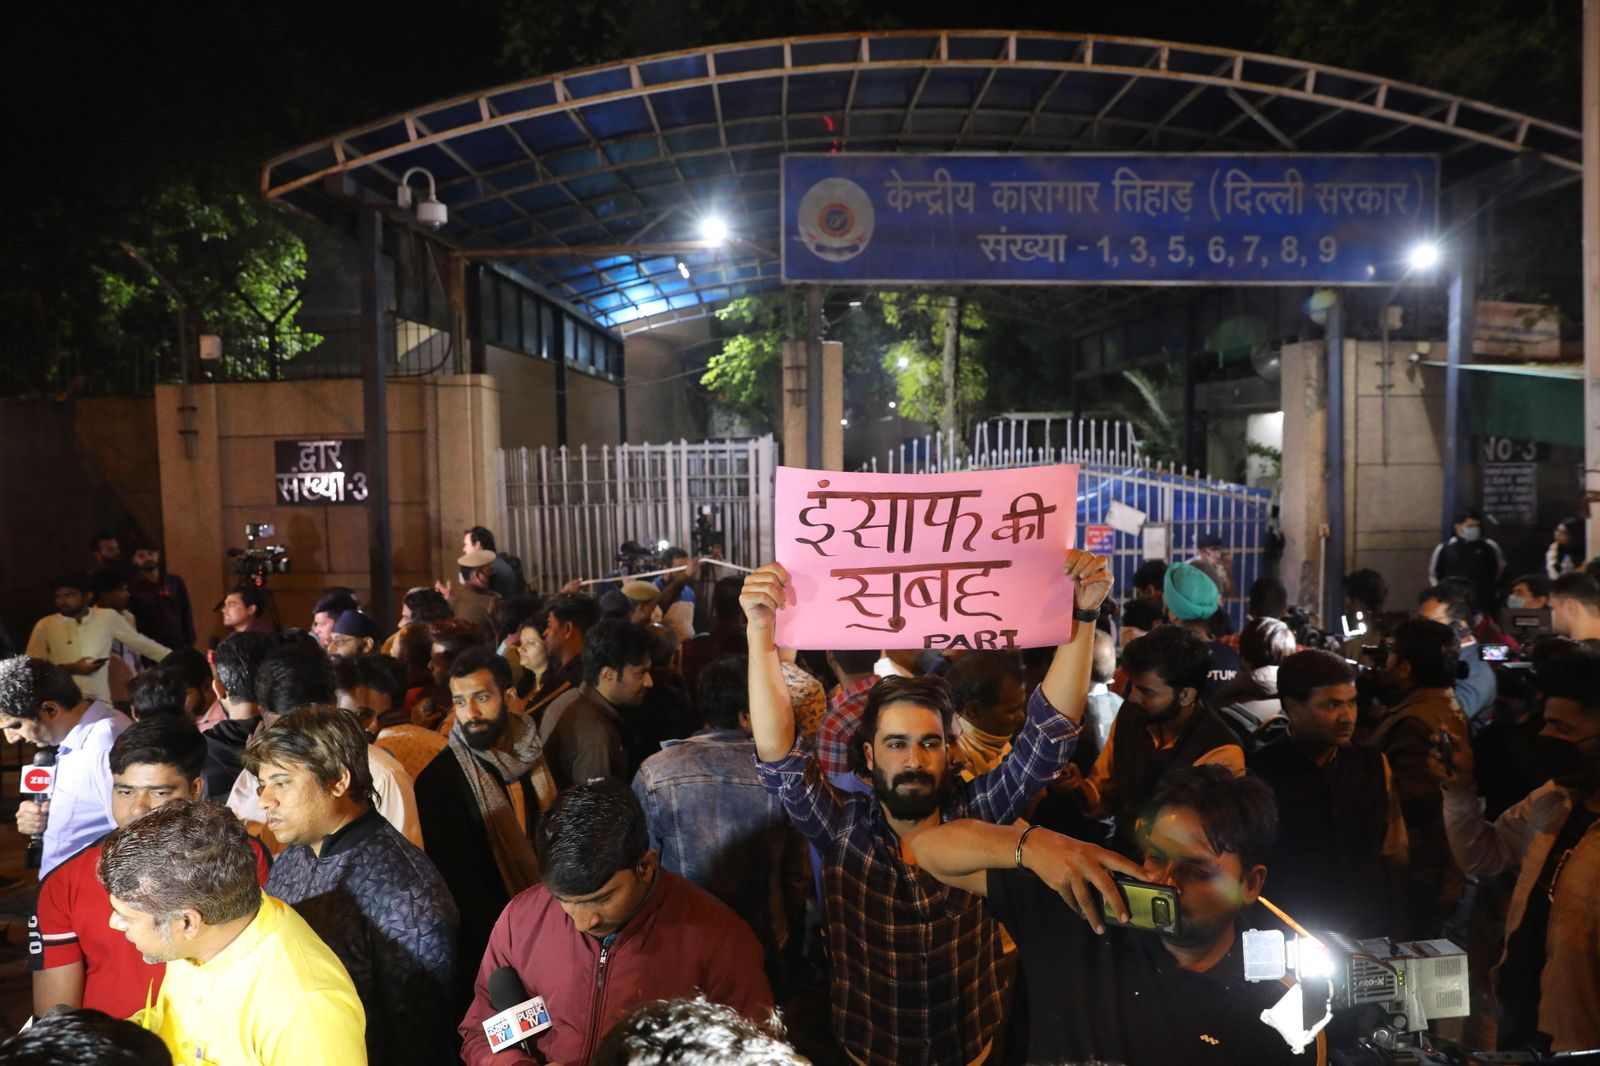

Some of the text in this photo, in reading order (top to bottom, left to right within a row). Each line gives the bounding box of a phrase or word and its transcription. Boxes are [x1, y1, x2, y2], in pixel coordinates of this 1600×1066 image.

[885, 168, 976, 215] केन्द्रीय
[990, 181, 1101, 213] कारागार
[977, 226, 1067, 263] संख्या
[1319, 235, 1338, 264] 9
[795, 479, 1057, 557] इंसाफ की
[830, 560, 1012, 633] सुबह
[30, 776, 52, 785] ZEE
[516, 1003, 546, 1022] PUBLIC
[527, 1014, 540, 1028] TV
